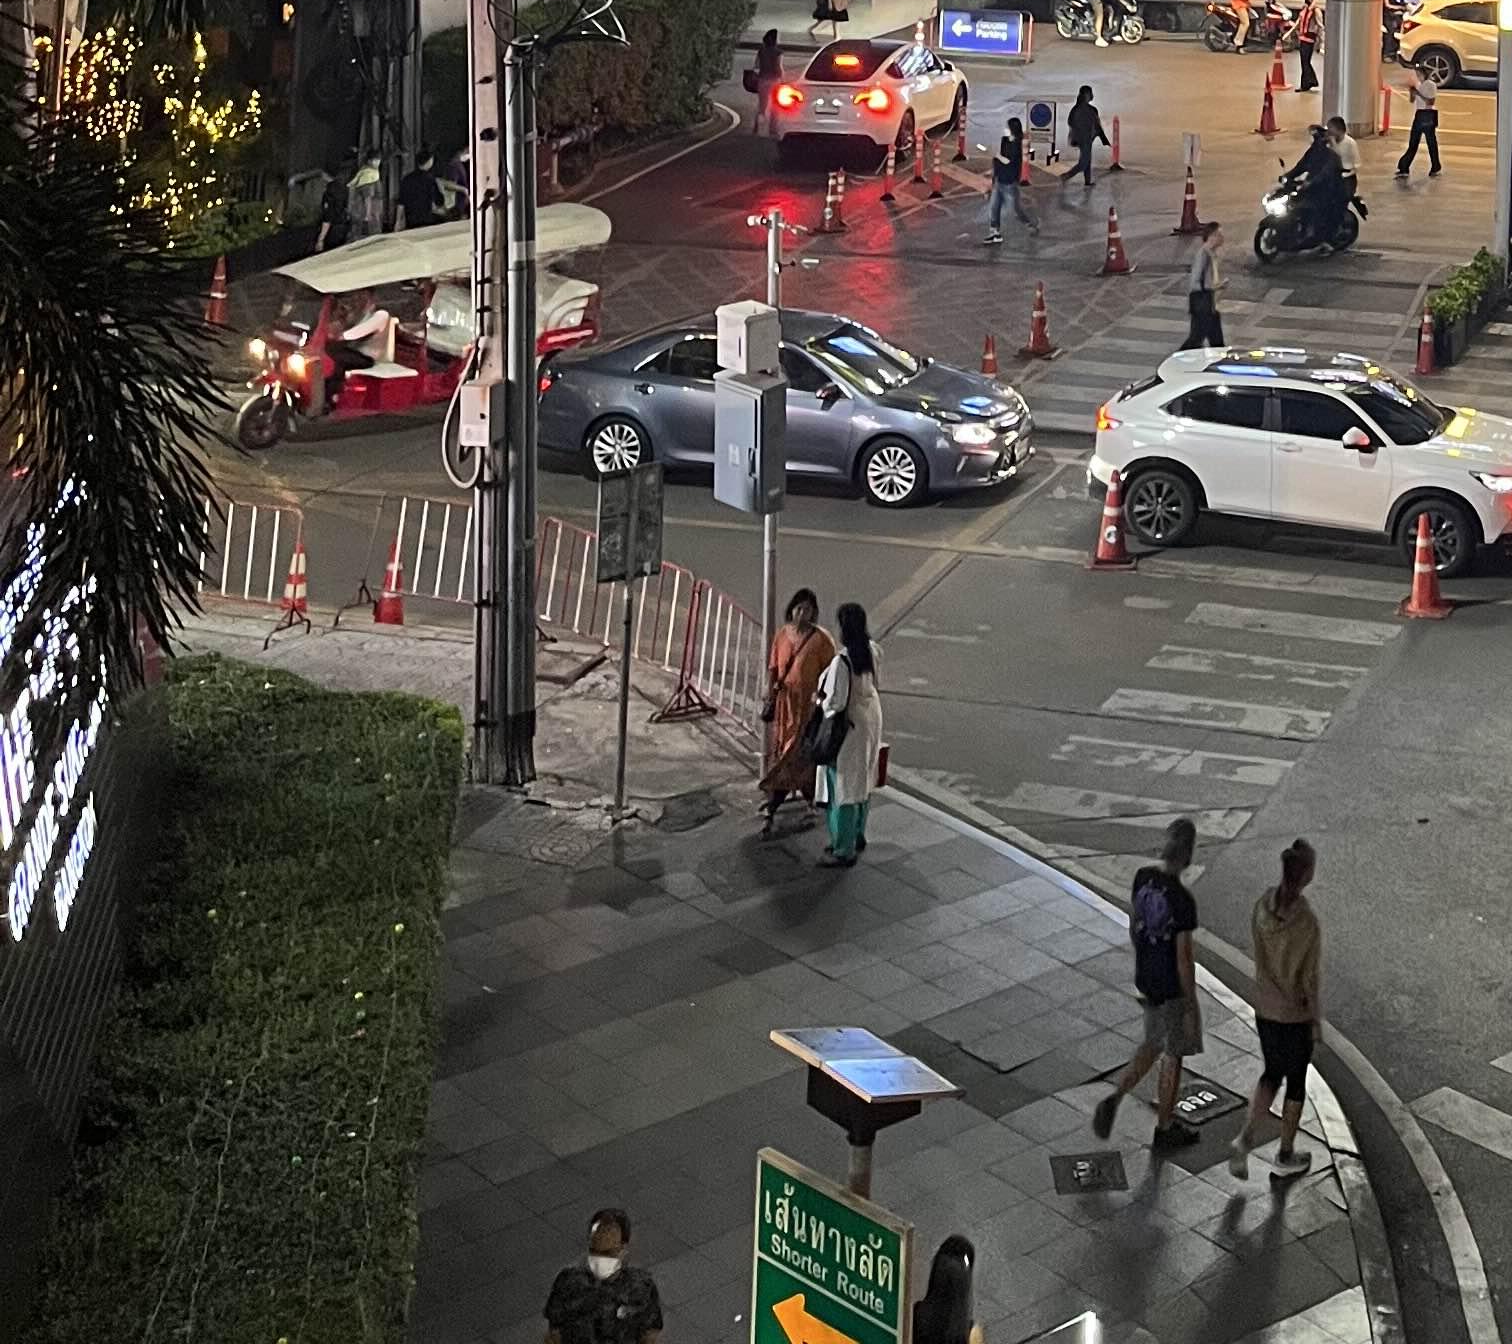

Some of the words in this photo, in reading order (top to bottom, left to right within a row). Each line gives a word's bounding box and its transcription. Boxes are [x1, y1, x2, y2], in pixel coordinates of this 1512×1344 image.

[764, 1182, 894, 1293] เส้นทางลัด
[771, 1233, 829, 1282] Shorter
[836, 1270, 885, 1315] Route
